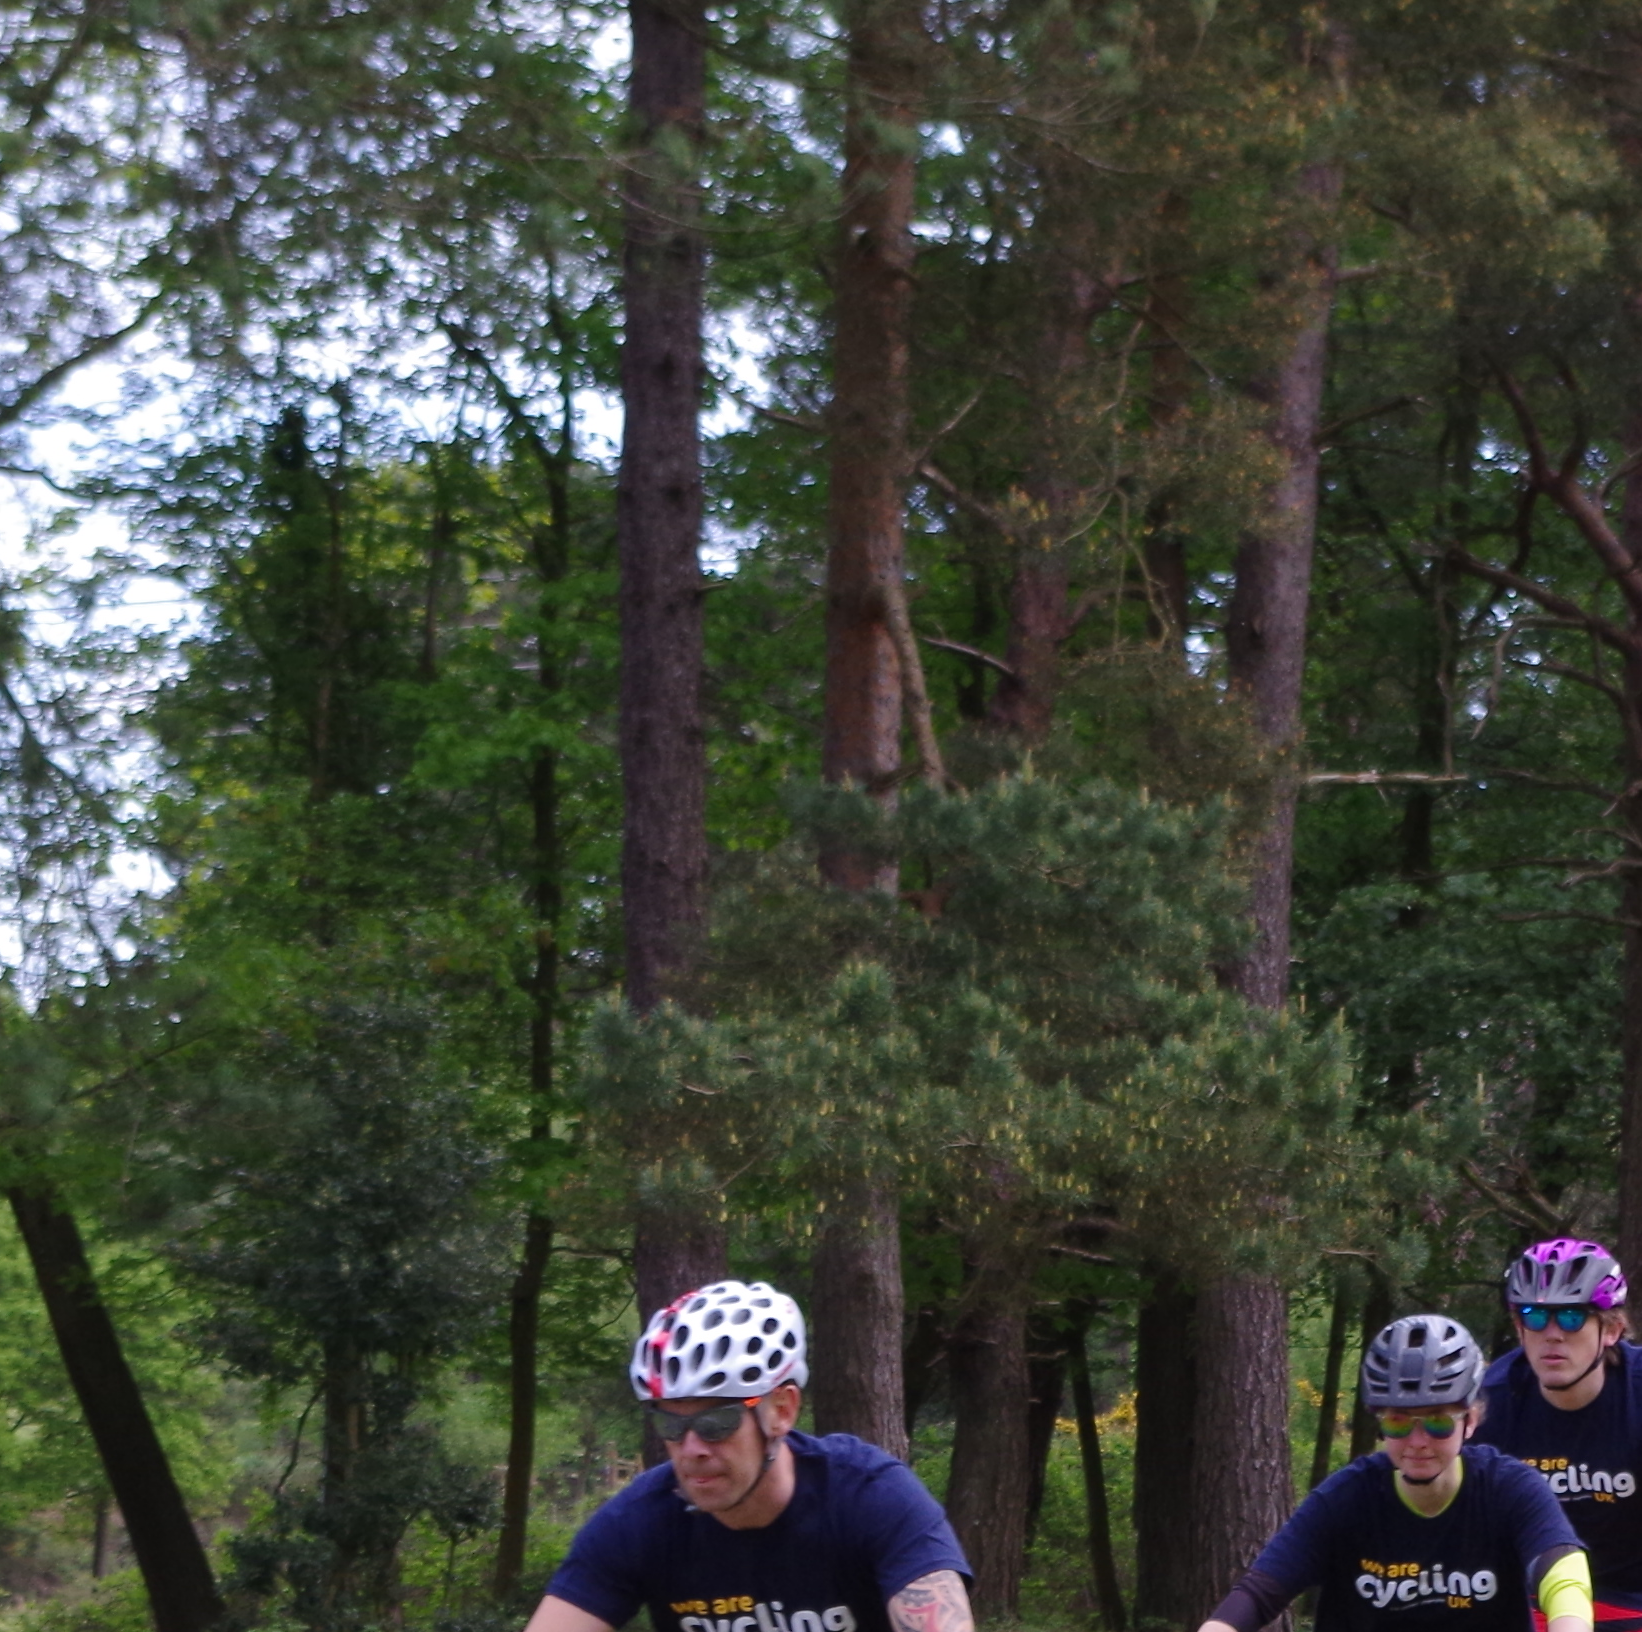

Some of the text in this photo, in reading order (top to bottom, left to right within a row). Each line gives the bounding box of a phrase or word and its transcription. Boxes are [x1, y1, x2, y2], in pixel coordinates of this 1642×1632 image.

[1540, 1458, 1568, 1471] are
[1541, 1463, 1636, 1498] cling
[1387, 1562, 1420, 1578] are
[1356, 1563, 1497, 1608] cycling
[670, 1595, 754, 1615] we are
[1447, 1595, 1472, 1608] UK
